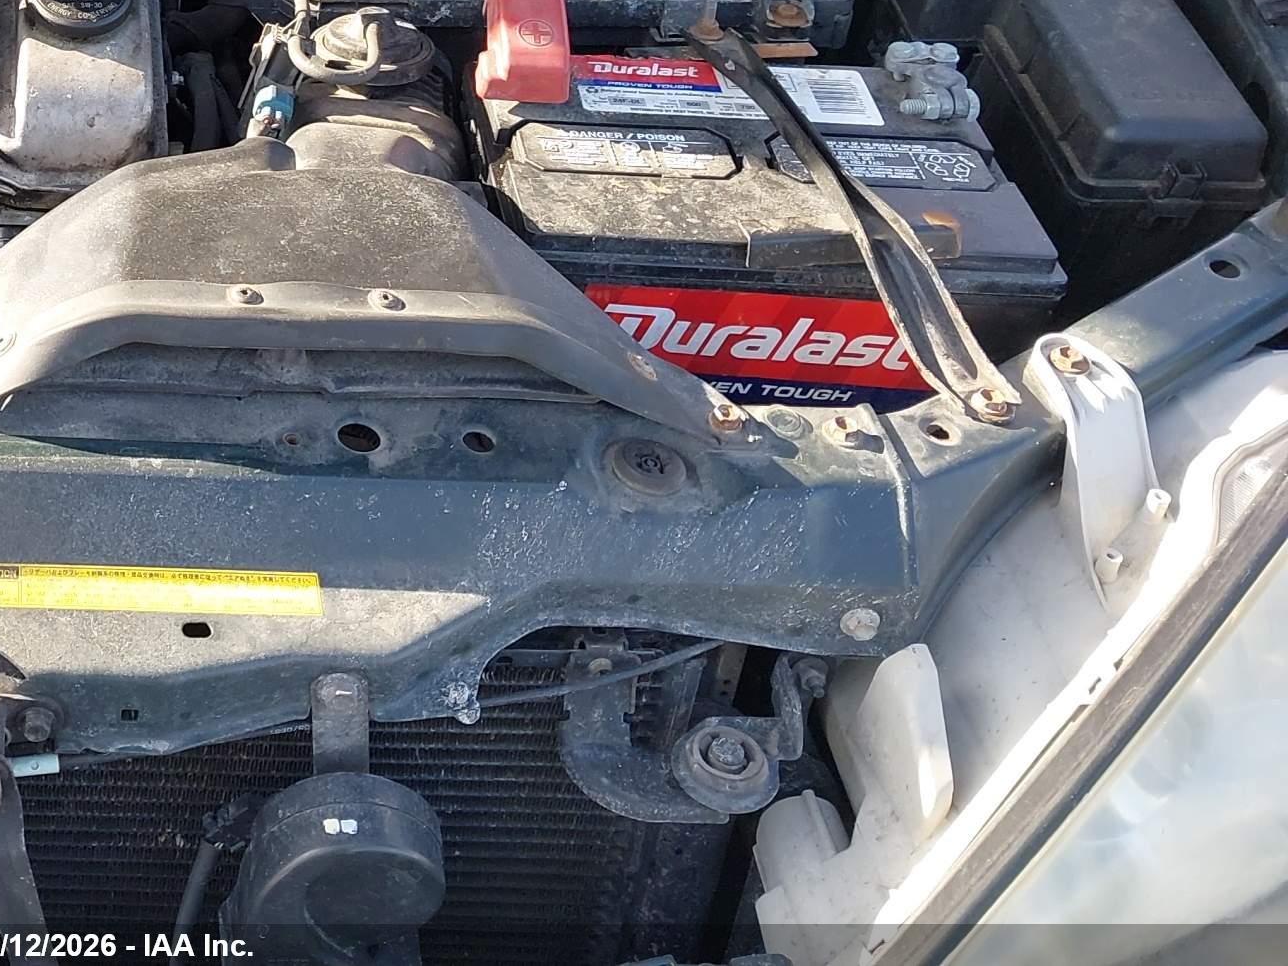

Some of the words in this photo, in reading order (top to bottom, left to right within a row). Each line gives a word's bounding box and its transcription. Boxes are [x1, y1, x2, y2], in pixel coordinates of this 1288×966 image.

[47, 2, 72, 17] ENERGY
[587, 61, 699, 78] Duralast
[570, 130, 622, 139] DANGER
[637, 132, 685, 142] POISON
[603, 303, 910, 371] Duralast
[760, 384, 852, 402] TOUGH
